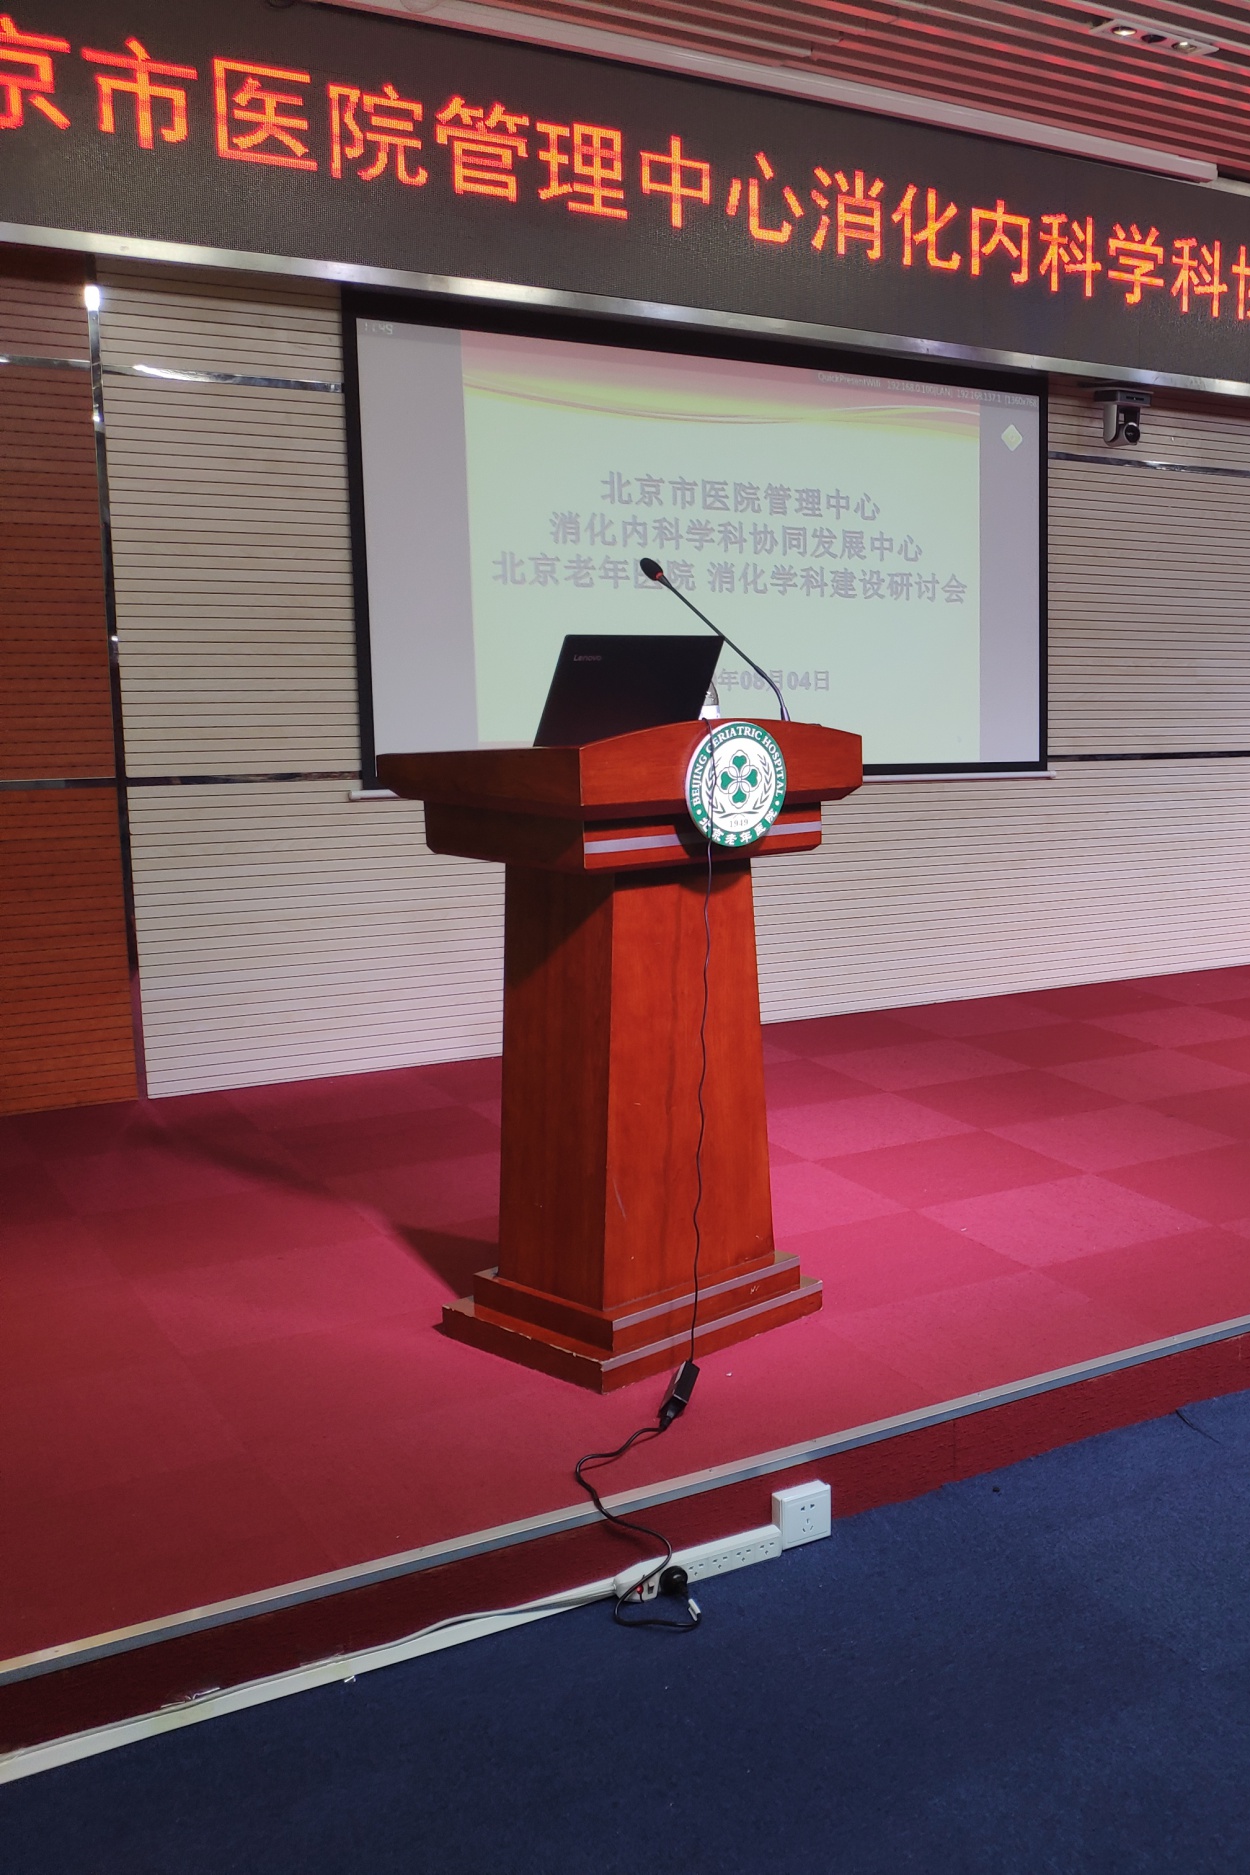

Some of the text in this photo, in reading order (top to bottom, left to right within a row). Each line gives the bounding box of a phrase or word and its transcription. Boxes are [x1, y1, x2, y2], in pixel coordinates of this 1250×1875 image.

[600, 470, 881, 521] 北京市医院管理中心
[549, 510, 923, 563] 消化内科学科协同发展中心
[706, 560, 968, 605] 消化学科建设研讨会
[713, 668, 830, 692] 年08月04日
[691, 725, 785, 807] BEIJING GERIATRIC HOSPITAL
[699, 807, 778, 846] 北京老年医院
[729, 818, 749, 828] 1949
